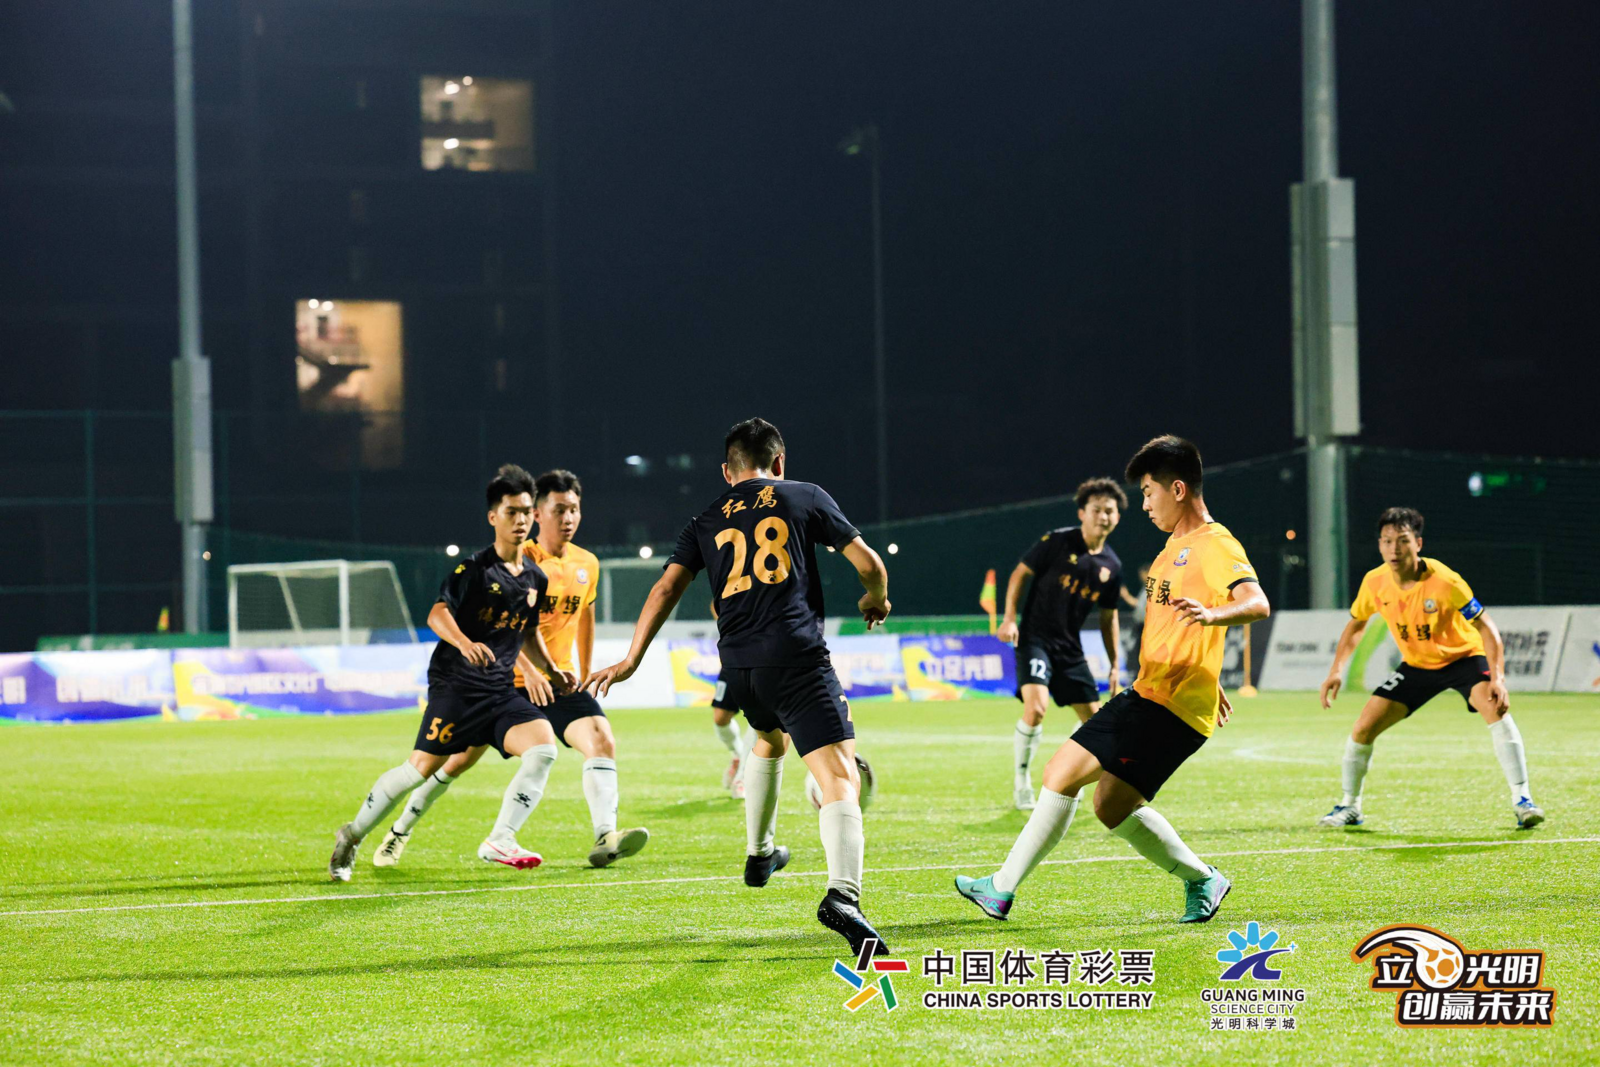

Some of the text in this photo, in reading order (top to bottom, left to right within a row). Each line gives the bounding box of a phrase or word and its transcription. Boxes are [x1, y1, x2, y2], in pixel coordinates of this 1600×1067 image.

[721, 485, 778, 519] 红鹰
[714, 516, 791, 599] 28
[1029, 658, 1047, 679] 12
[425, 717, 456, 745] 56
